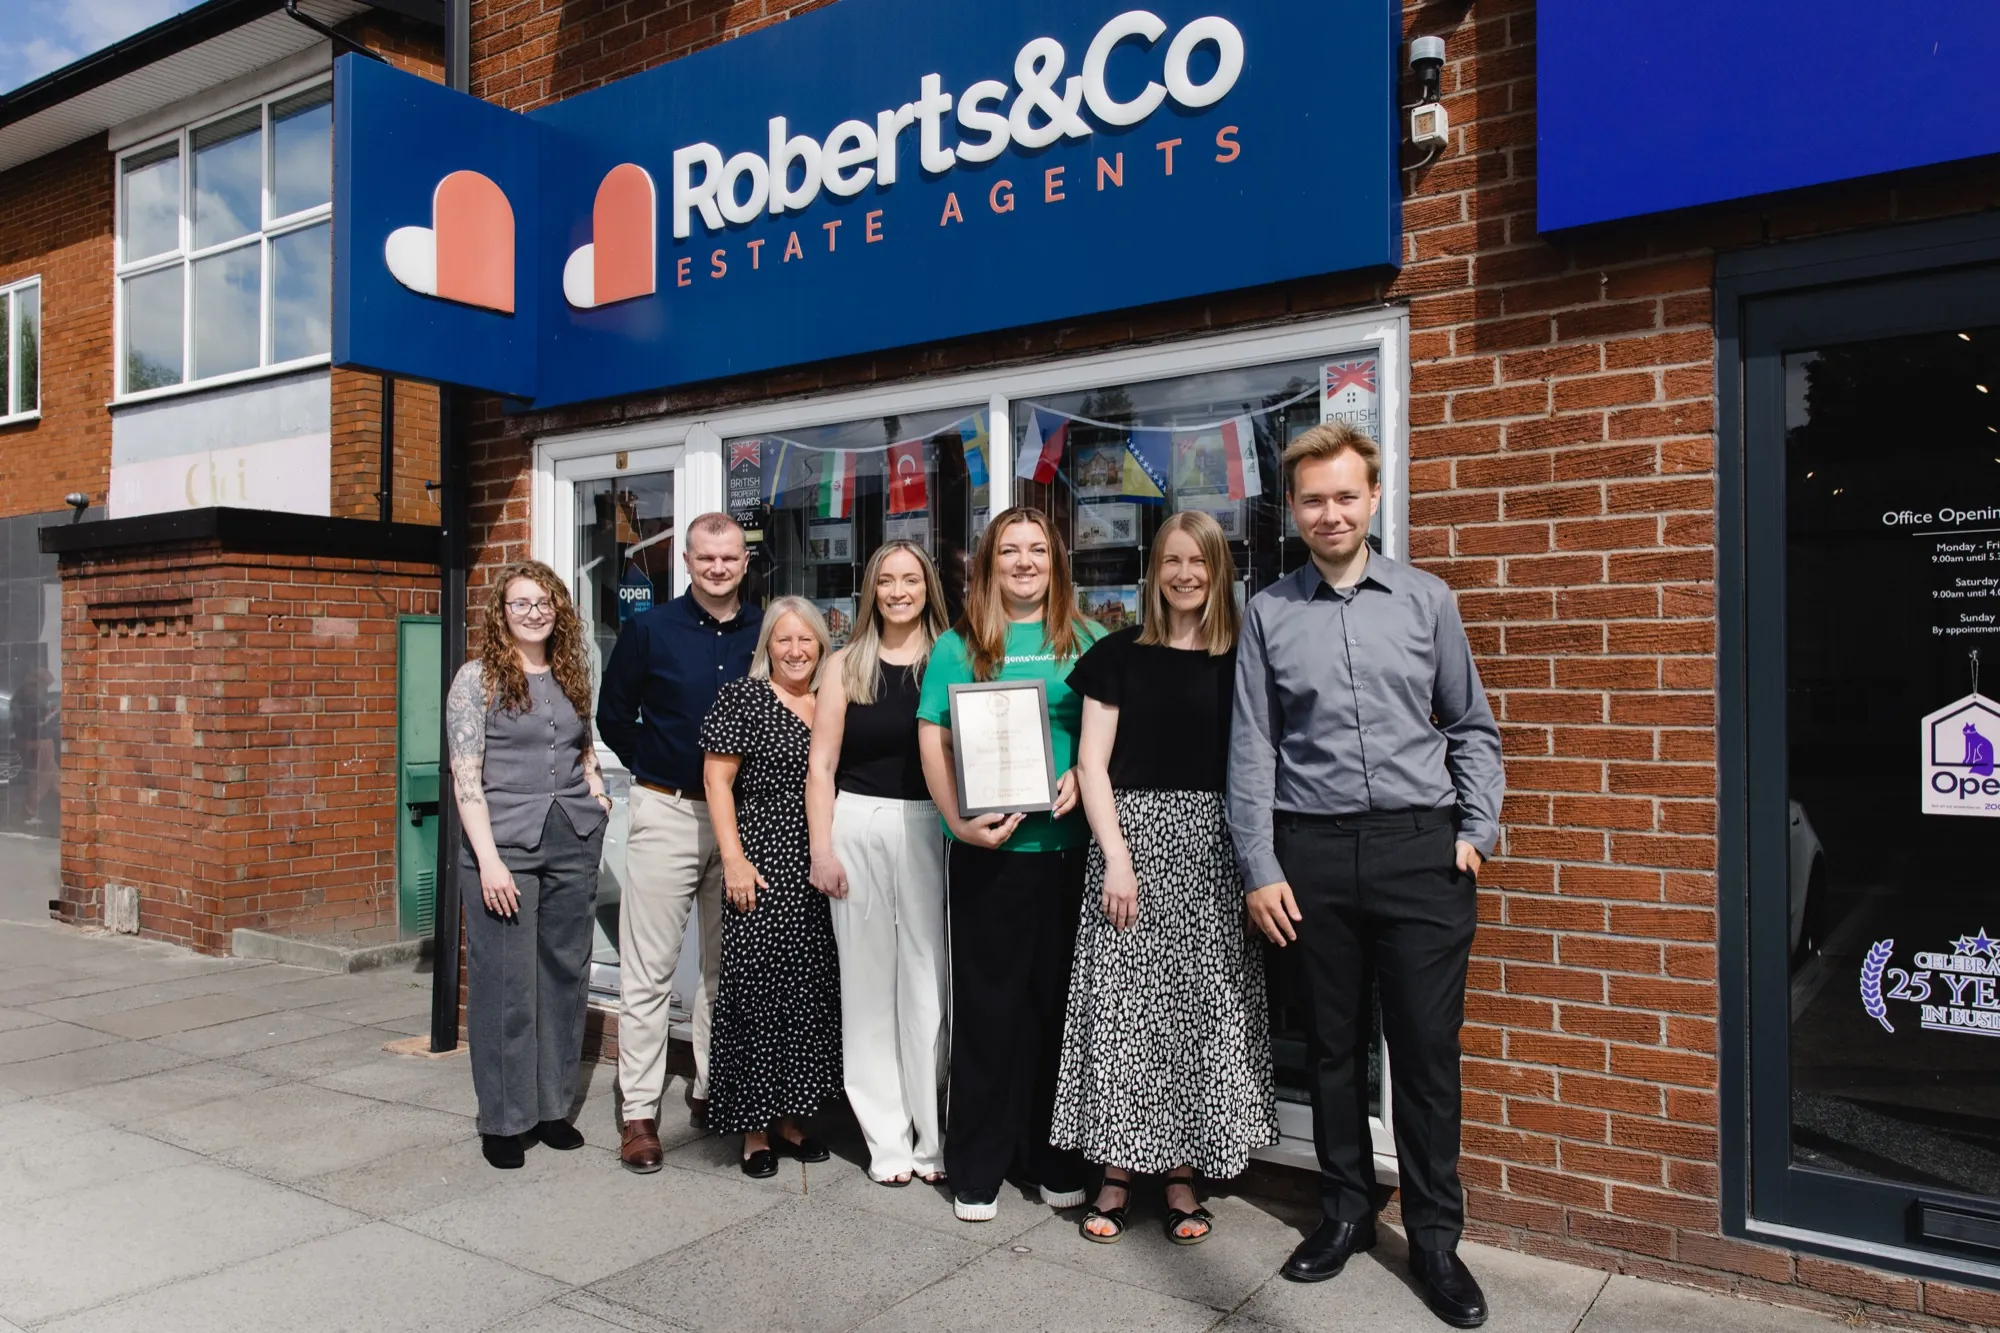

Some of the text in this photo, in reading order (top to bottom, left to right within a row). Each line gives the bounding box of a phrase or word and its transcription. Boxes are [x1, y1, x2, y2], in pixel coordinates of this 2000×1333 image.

[673, 10, 1245, 238] Roberts&Co
[677, 125, 1241, 287] ESTATE AGENTS
[730, 476, 760, 489] BRITISH
[730, 488, 760, 499] PROPERTY
[730, 497, 761, 508] AWARDS
[736, 511, 754, 522] 2025
[1882, 510, 1933, 525] Office
[1936, 542, 1976, 553] Monday
[1931, 554, 1964, 563] 9.00am
[1966, 553, 1986, 562] until
[1955, 577, 1999, 588] Saturday
[619, 587, 651, 604] open
[1932, 590, 1964, 599] 9.00am
[1967, 589, 1987, 597] until
[1960, 613, 1996, 624] Sunday
[1932, 626, 1944, 636] By
[1887, 968, 2000, 1010] 25 YE
[1921, 1004, 1948, 1024] IN
